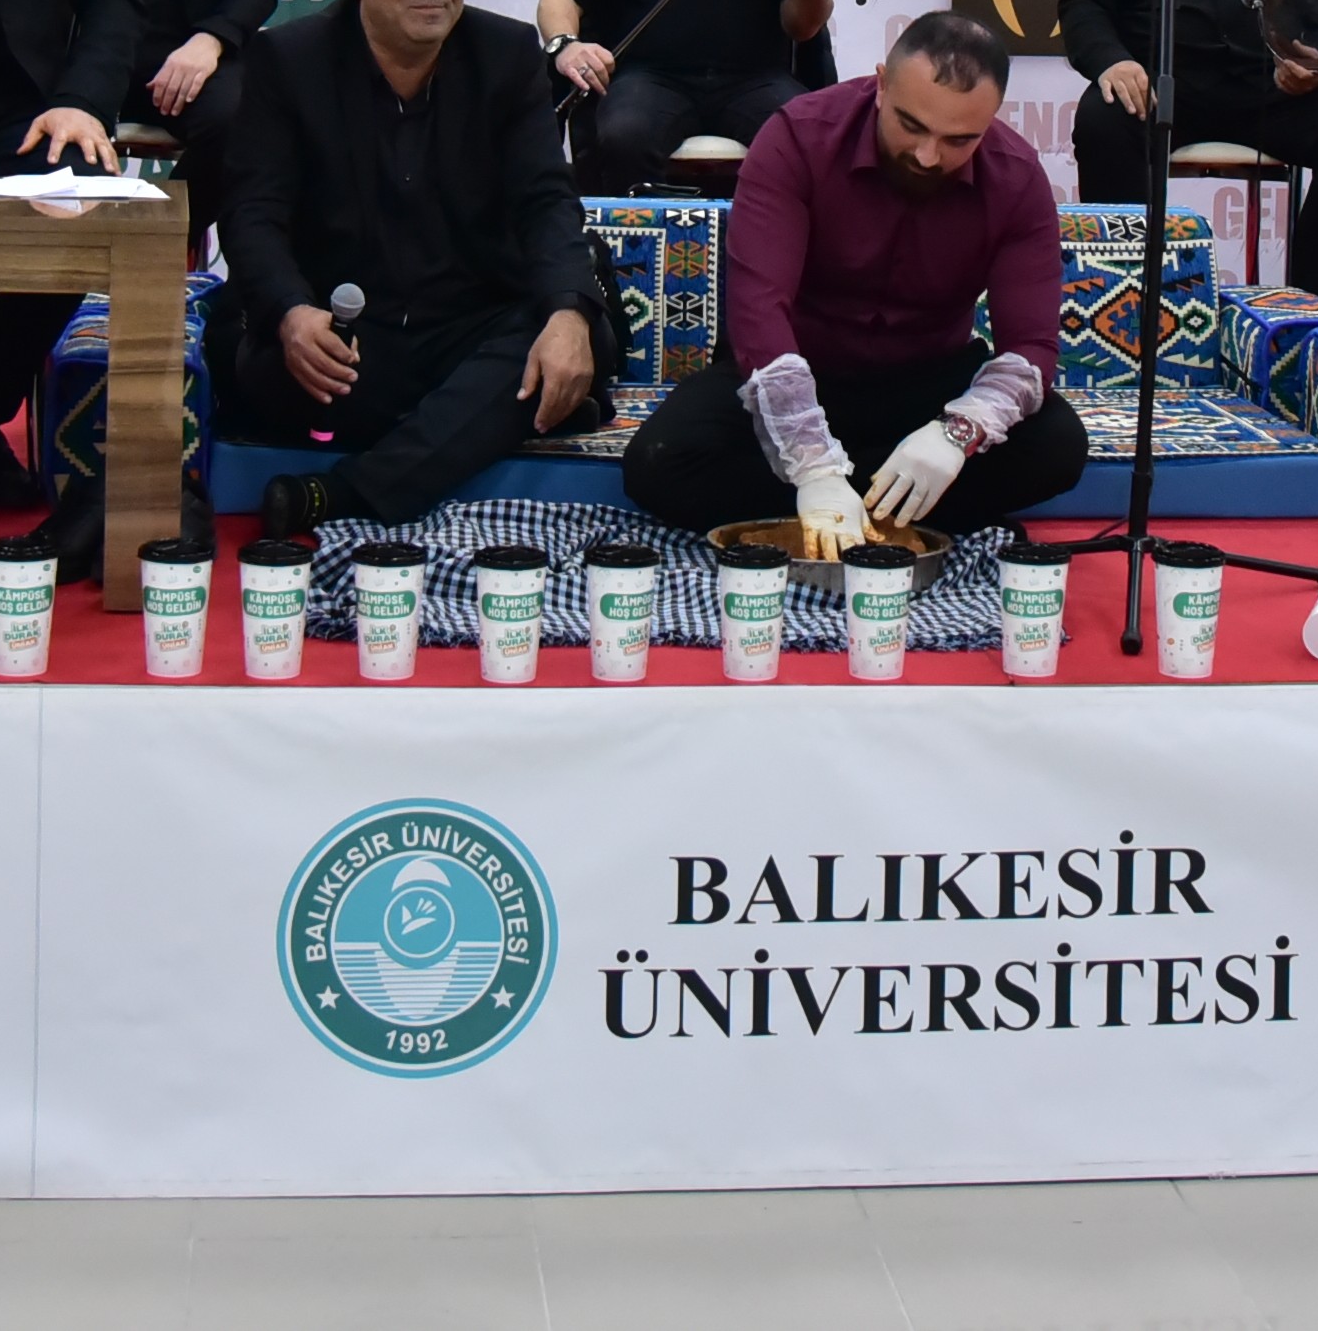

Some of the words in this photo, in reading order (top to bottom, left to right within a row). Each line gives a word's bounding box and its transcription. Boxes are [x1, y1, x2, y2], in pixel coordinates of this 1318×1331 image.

[305, 831, 392, 963] BALIKESİR
[399, 823, 531, 966] ÜNİVERSİTESİ
[667, 830, 1214, 925] BALIKESİR
[598, 935, 1300, 1040] ÜNİVERSİTESİ
[383, 1026, 450, 1054] 1992
